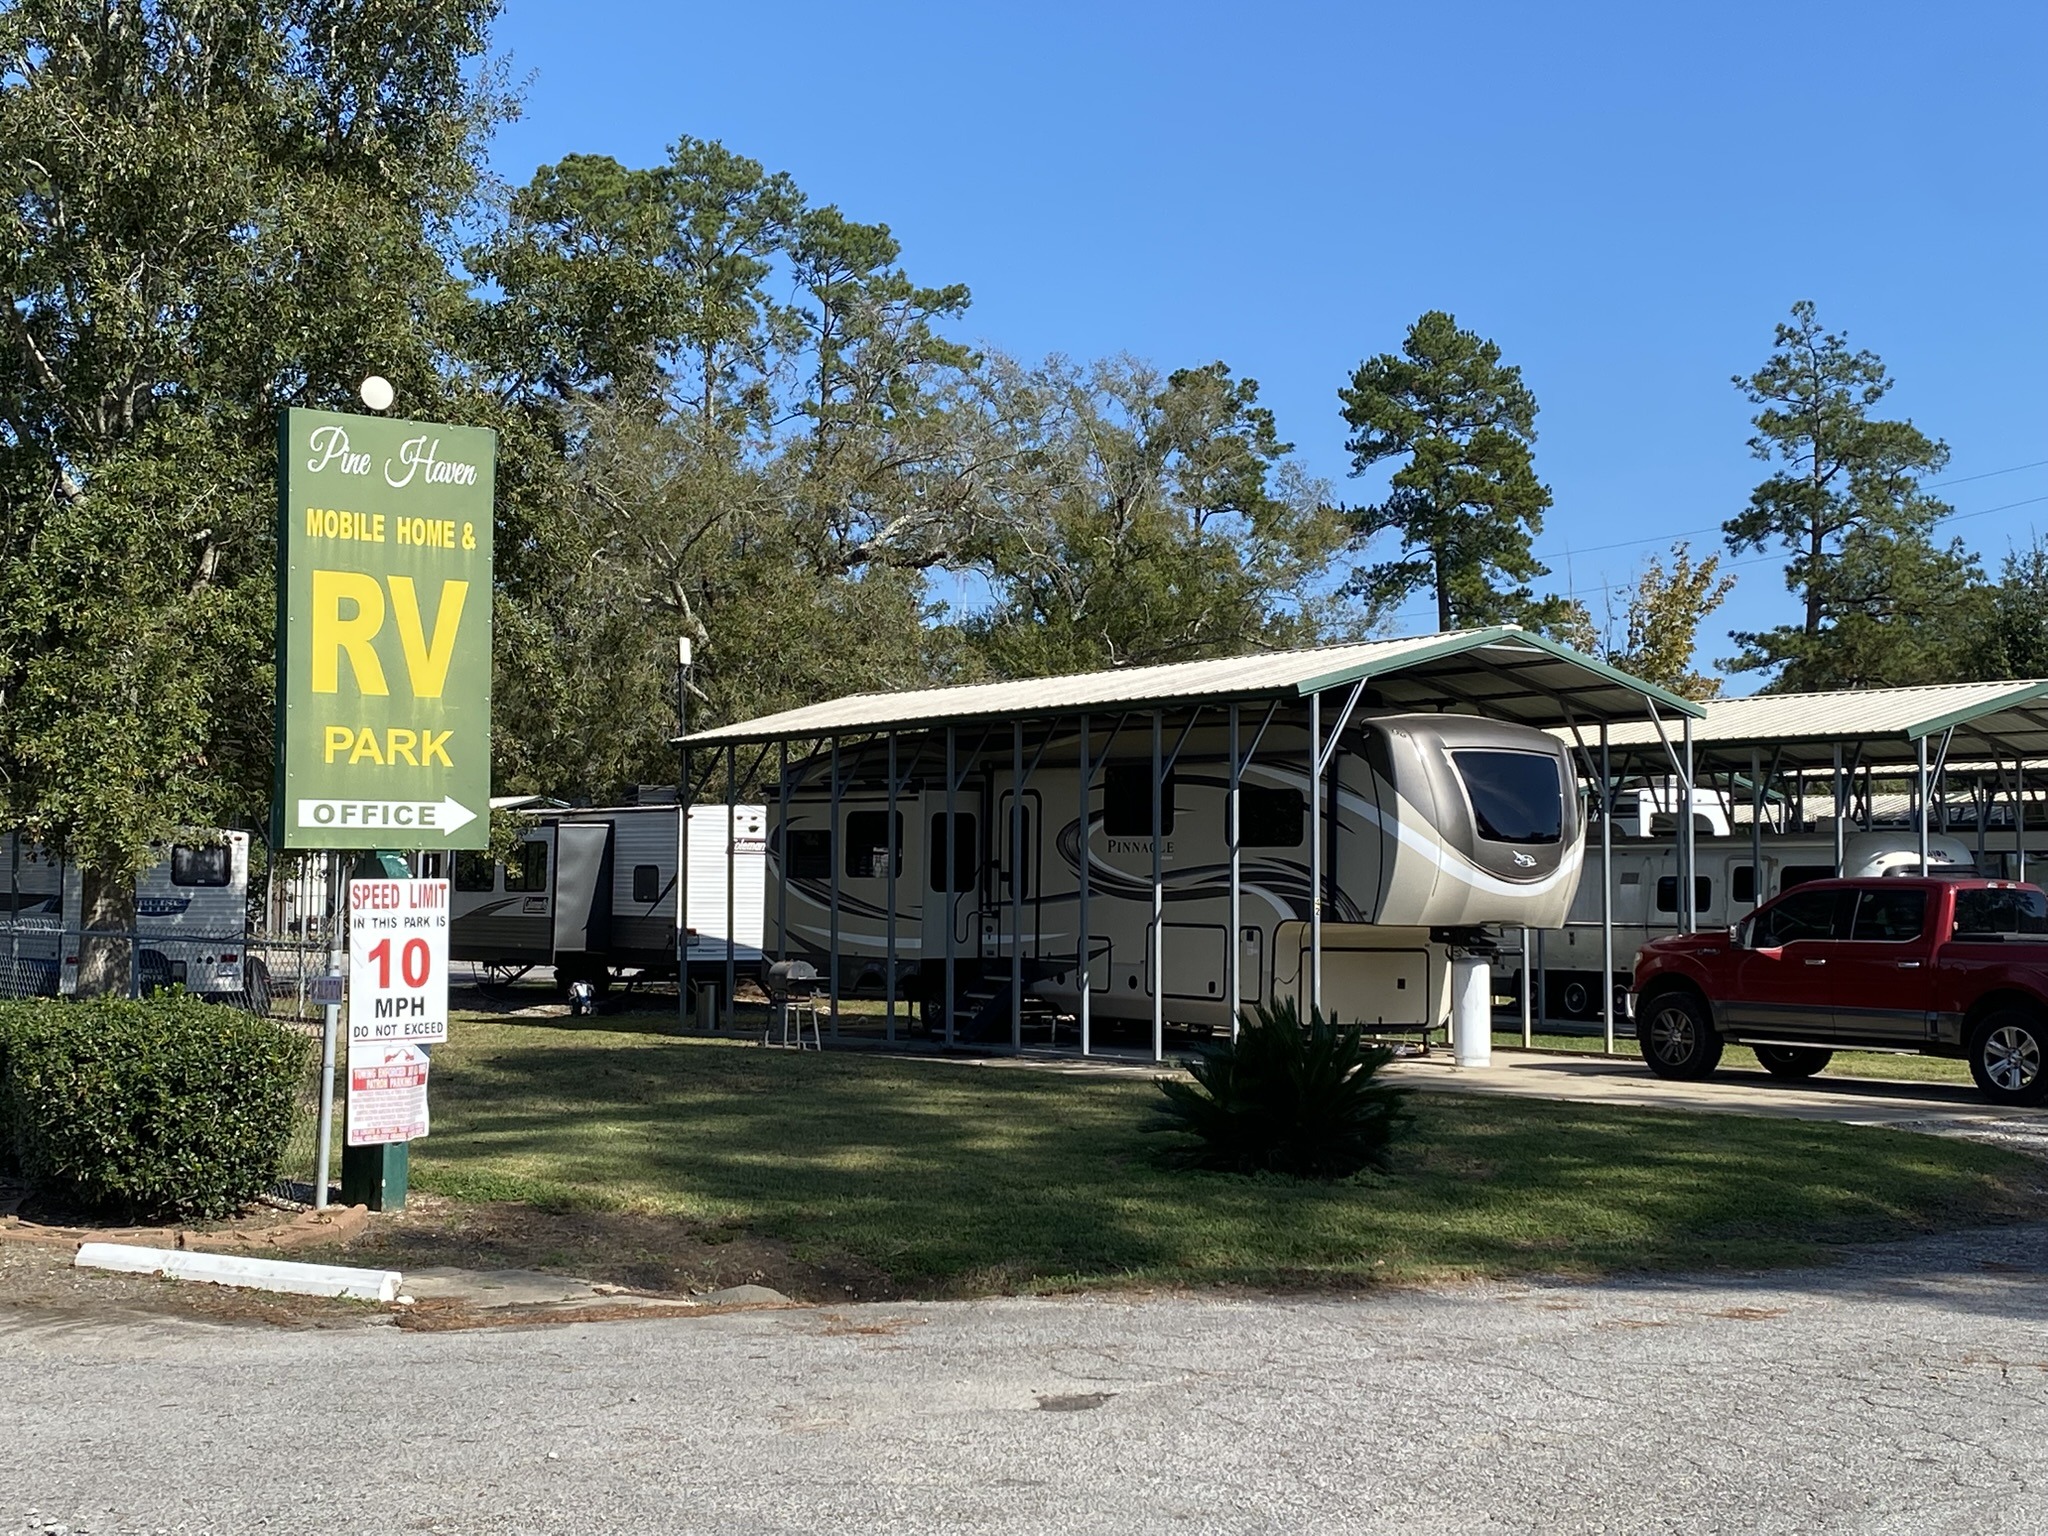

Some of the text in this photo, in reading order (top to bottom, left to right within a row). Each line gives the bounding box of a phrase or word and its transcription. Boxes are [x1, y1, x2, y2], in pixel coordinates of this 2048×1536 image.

[307, 426, 478, 488] Pine Haven
[306, 508, 477, 550] MOBILE HOME &
[312, 569, 470, 698] RV
[324, 725, 455, 768] PARK
[313, 803, 436, 826] OFFICE
[731, 838, 767, 851] oleman
[352, 883, 447, 910] SPEED LIMIT
[353, 916, 446, 929] IN THIS PARK IS
[368, 937, 431, 989] 10
[375, 996, 425, 1019] MPH
[353, 1021, 444, 1038] DO NOT EXCEED
